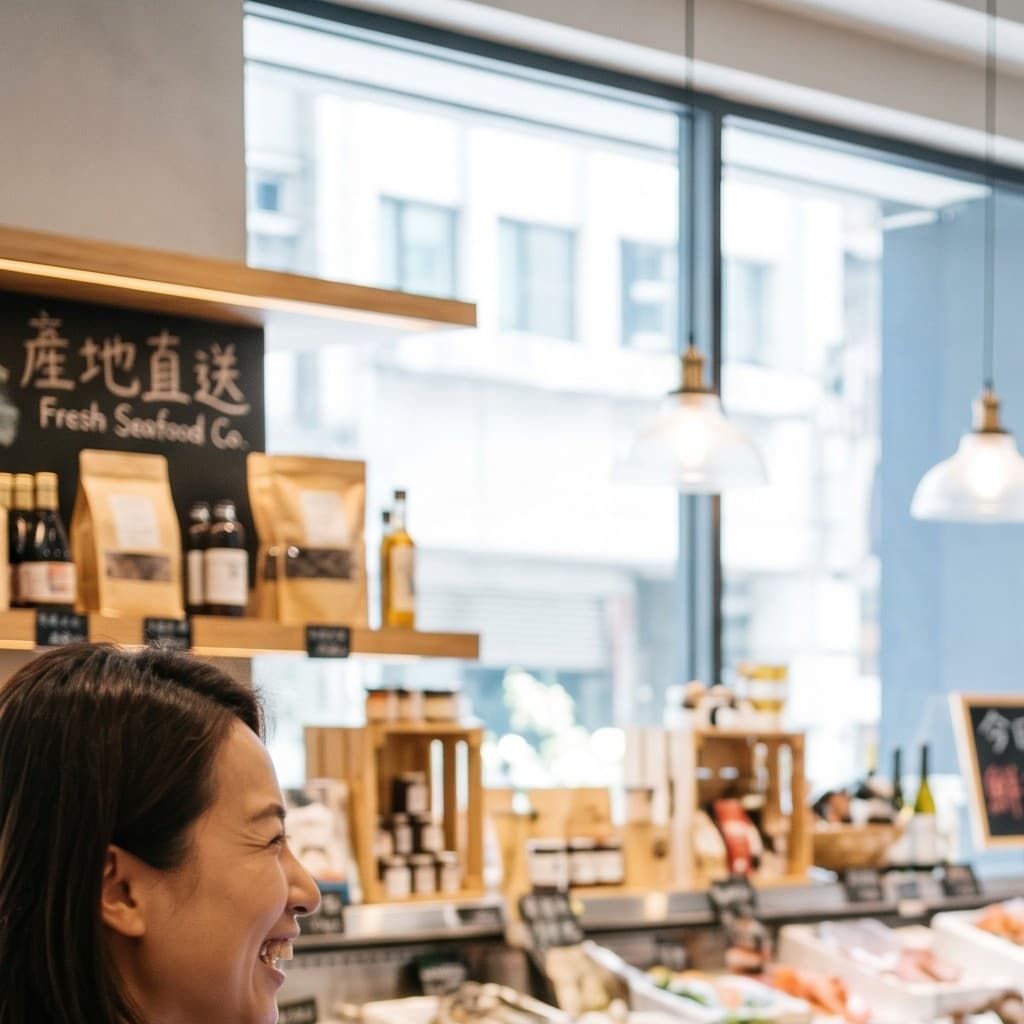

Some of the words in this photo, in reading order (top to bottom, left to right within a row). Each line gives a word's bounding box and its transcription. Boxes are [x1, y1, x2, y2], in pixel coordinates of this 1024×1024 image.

[20, 309, 250, 417] 產地直送
[39, 396, 108, 434] Fresh
[114, 402, 206, 446] Seafood
